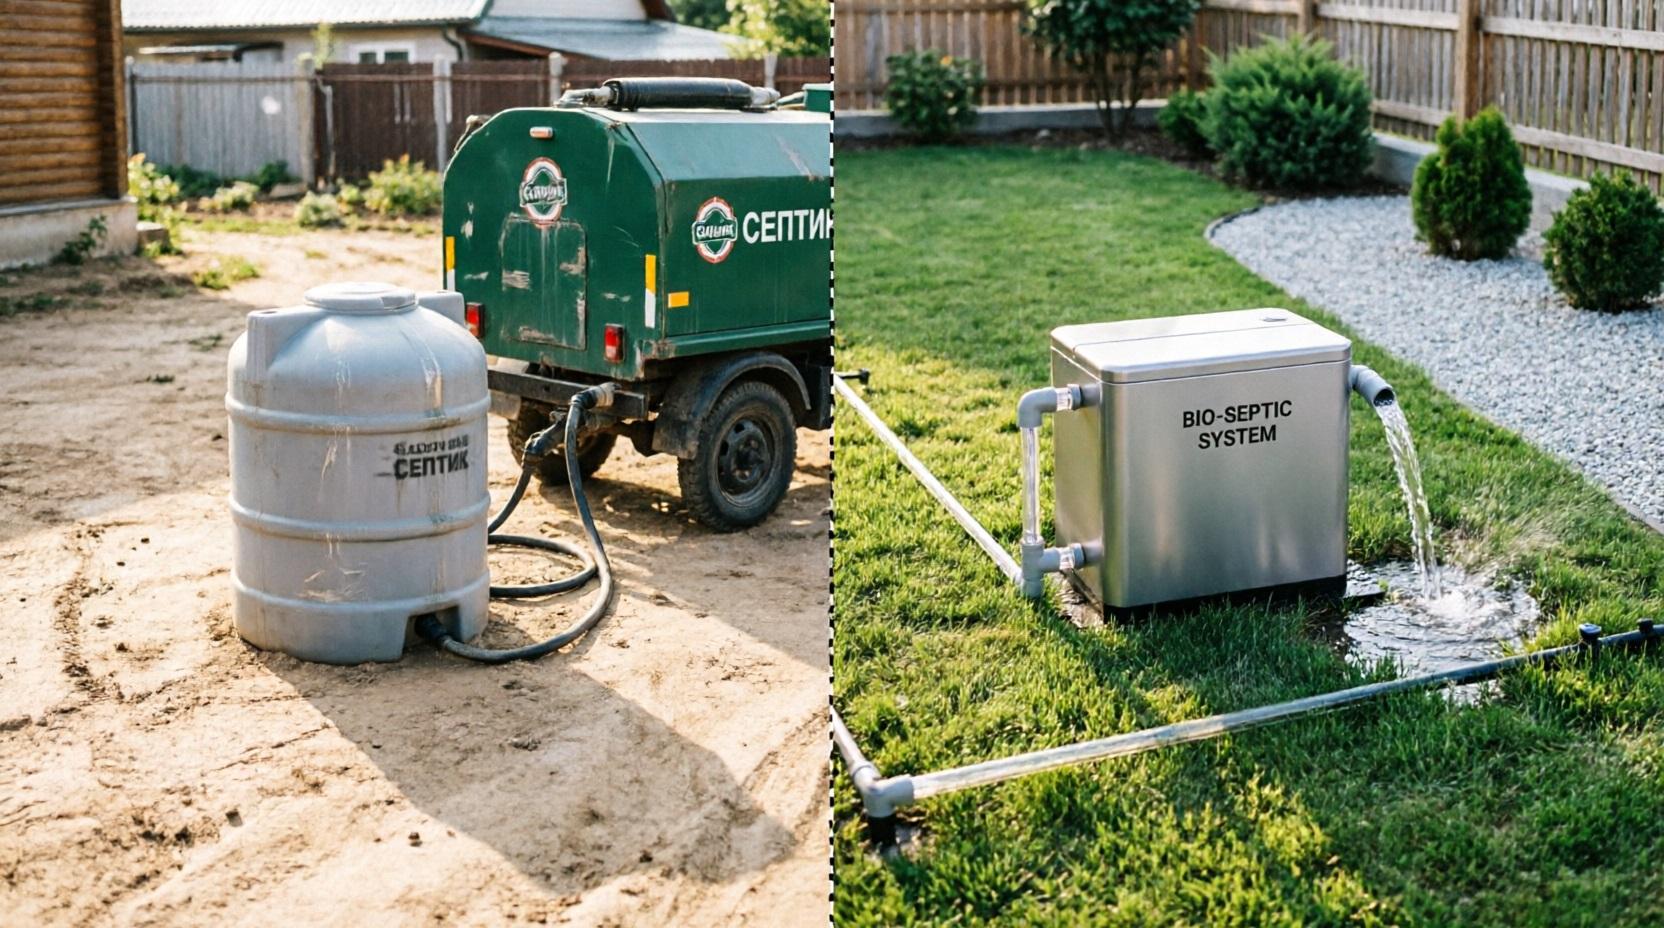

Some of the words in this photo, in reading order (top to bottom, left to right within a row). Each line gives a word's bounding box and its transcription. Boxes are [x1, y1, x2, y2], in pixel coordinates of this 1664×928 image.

[1183, 400, 1292, 428] BIO-SEPTIC
[1198, 424, 1277, 449] SYSTEM
[393, 449, 469, 480] СЕПТИК
